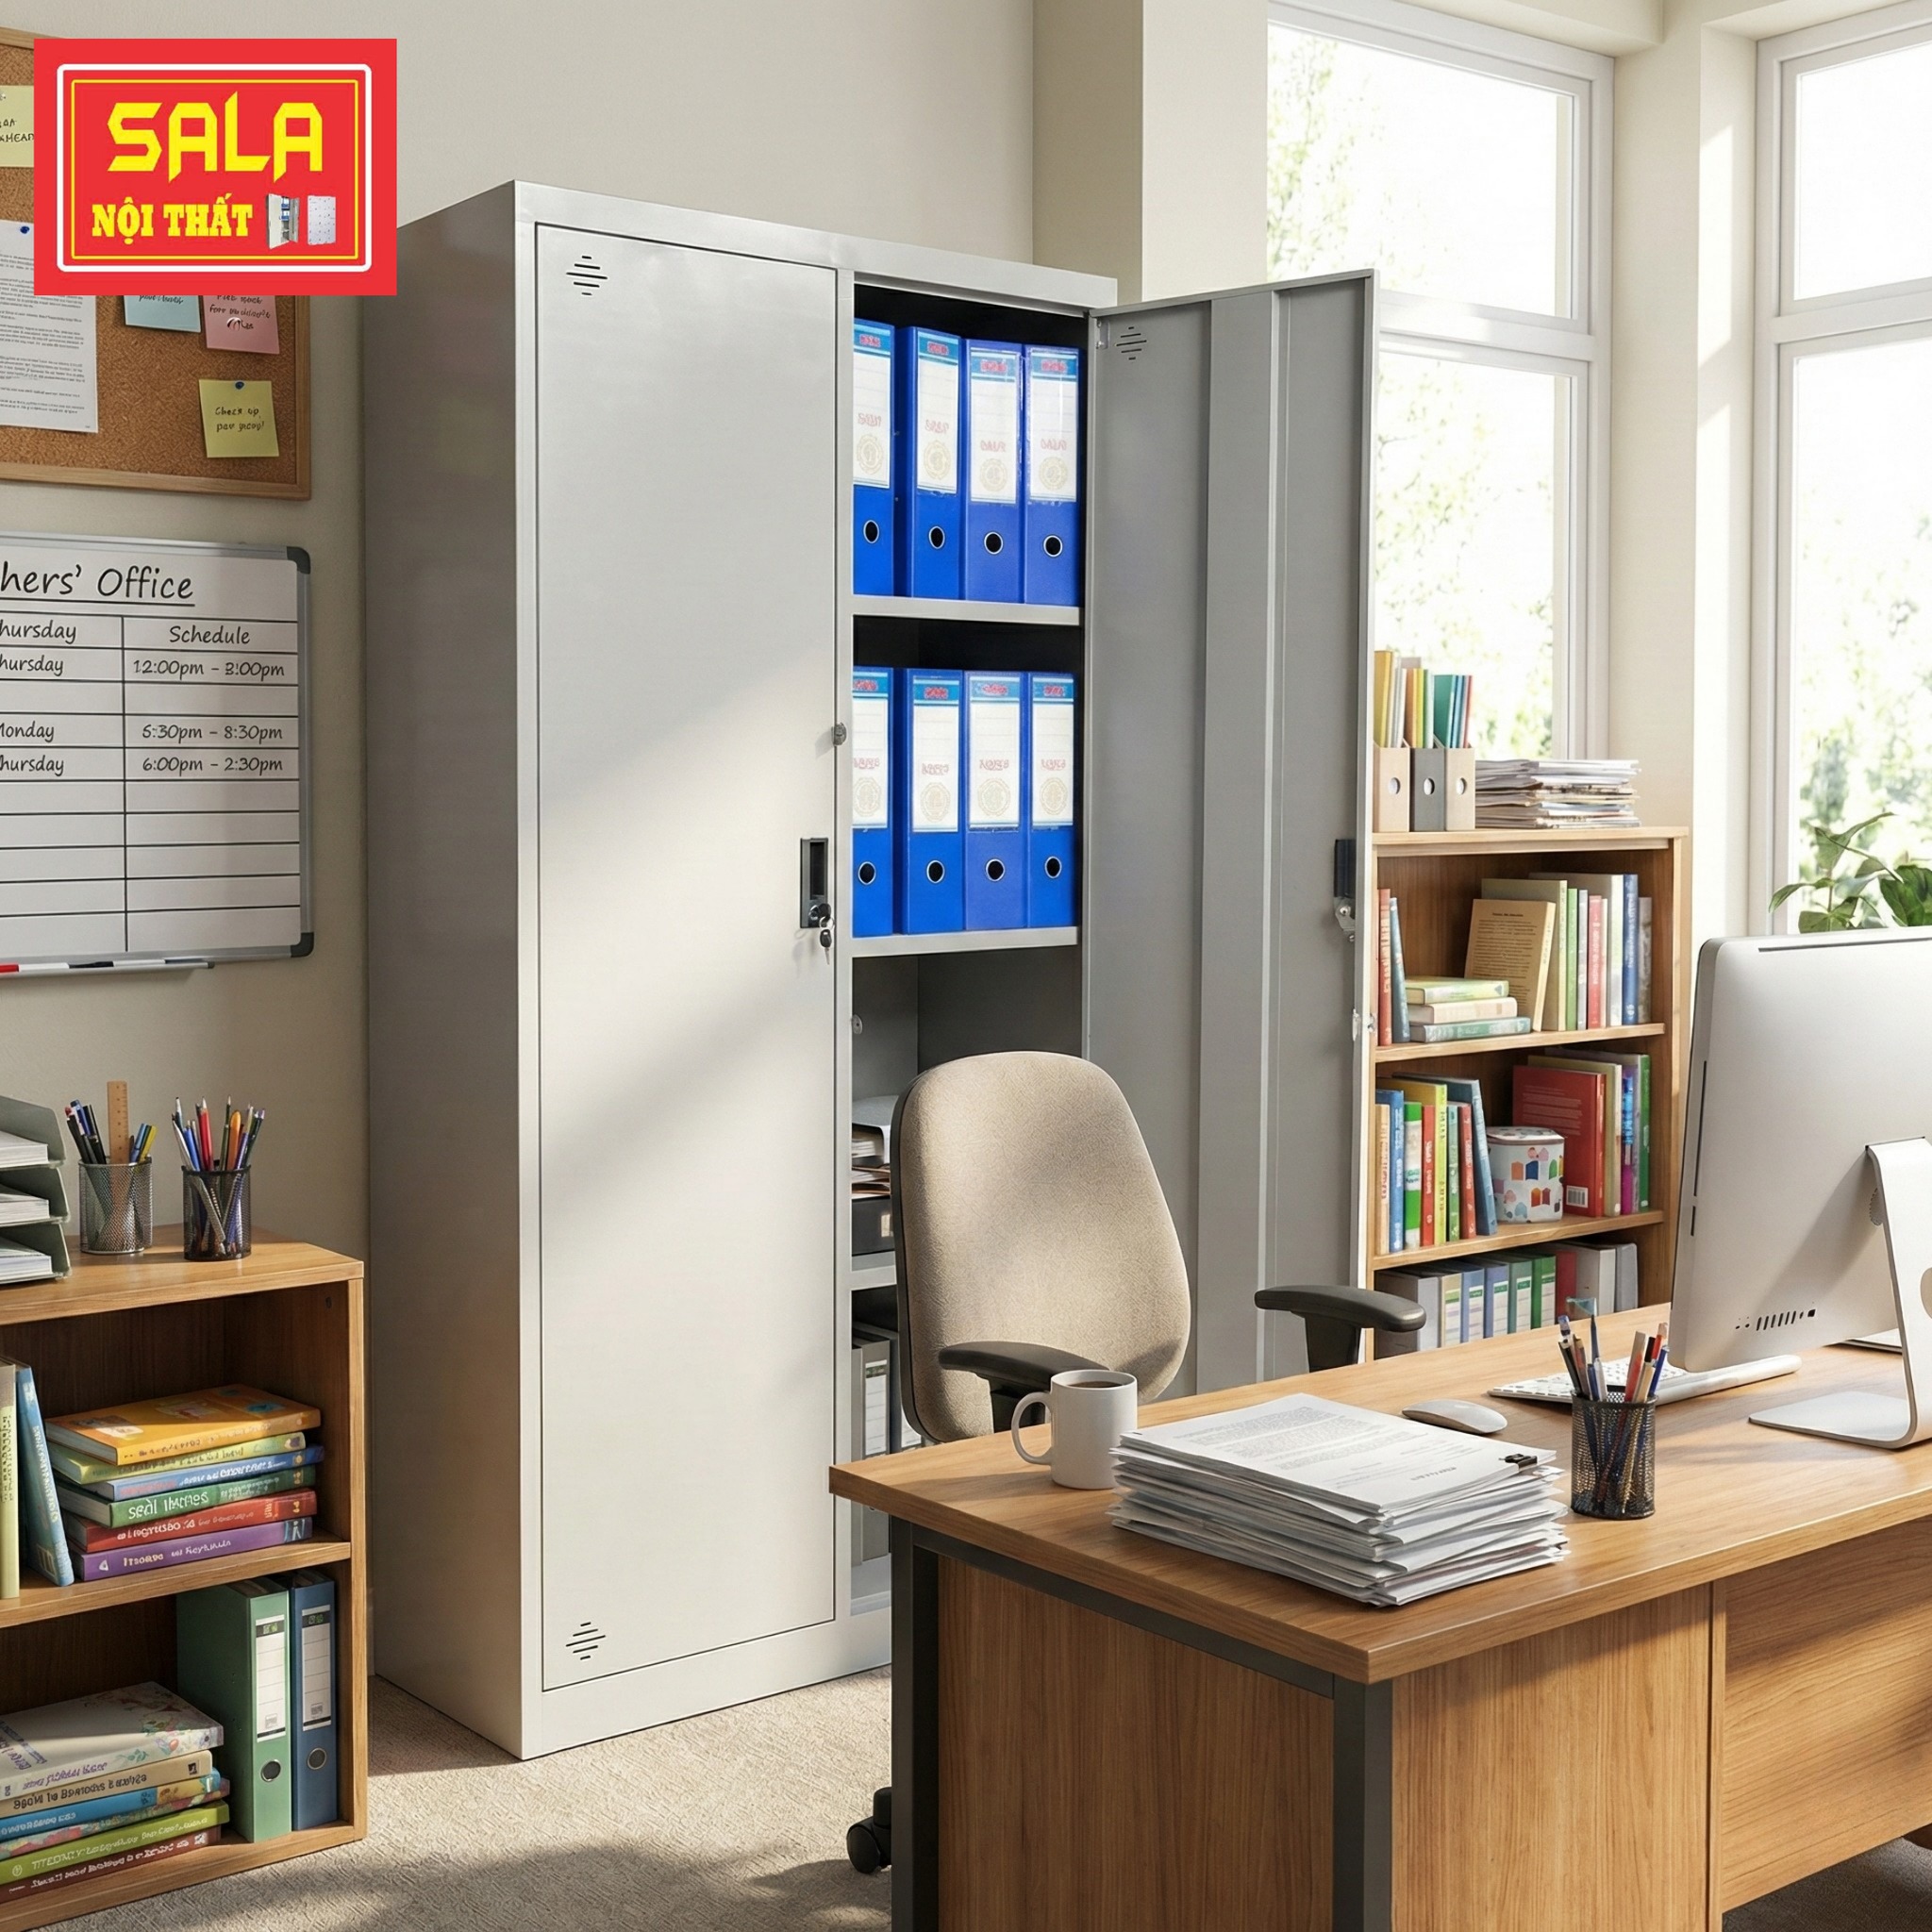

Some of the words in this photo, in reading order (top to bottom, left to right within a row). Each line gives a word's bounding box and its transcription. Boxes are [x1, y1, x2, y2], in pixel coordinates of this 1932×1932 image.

[97, 565, 194, 599] Office
[0, 619, 76, 645] hursday
[169, 624, 251, 645] Schedule
[0, 653, 64, 677] hursday
[133, 659, 205, 681] 12:00pm
[224, 724, 283, 745] 8:30pm
[142, 757, 203, 777] 6:00pm
[224, 757, 283, 776] 2:30pm
